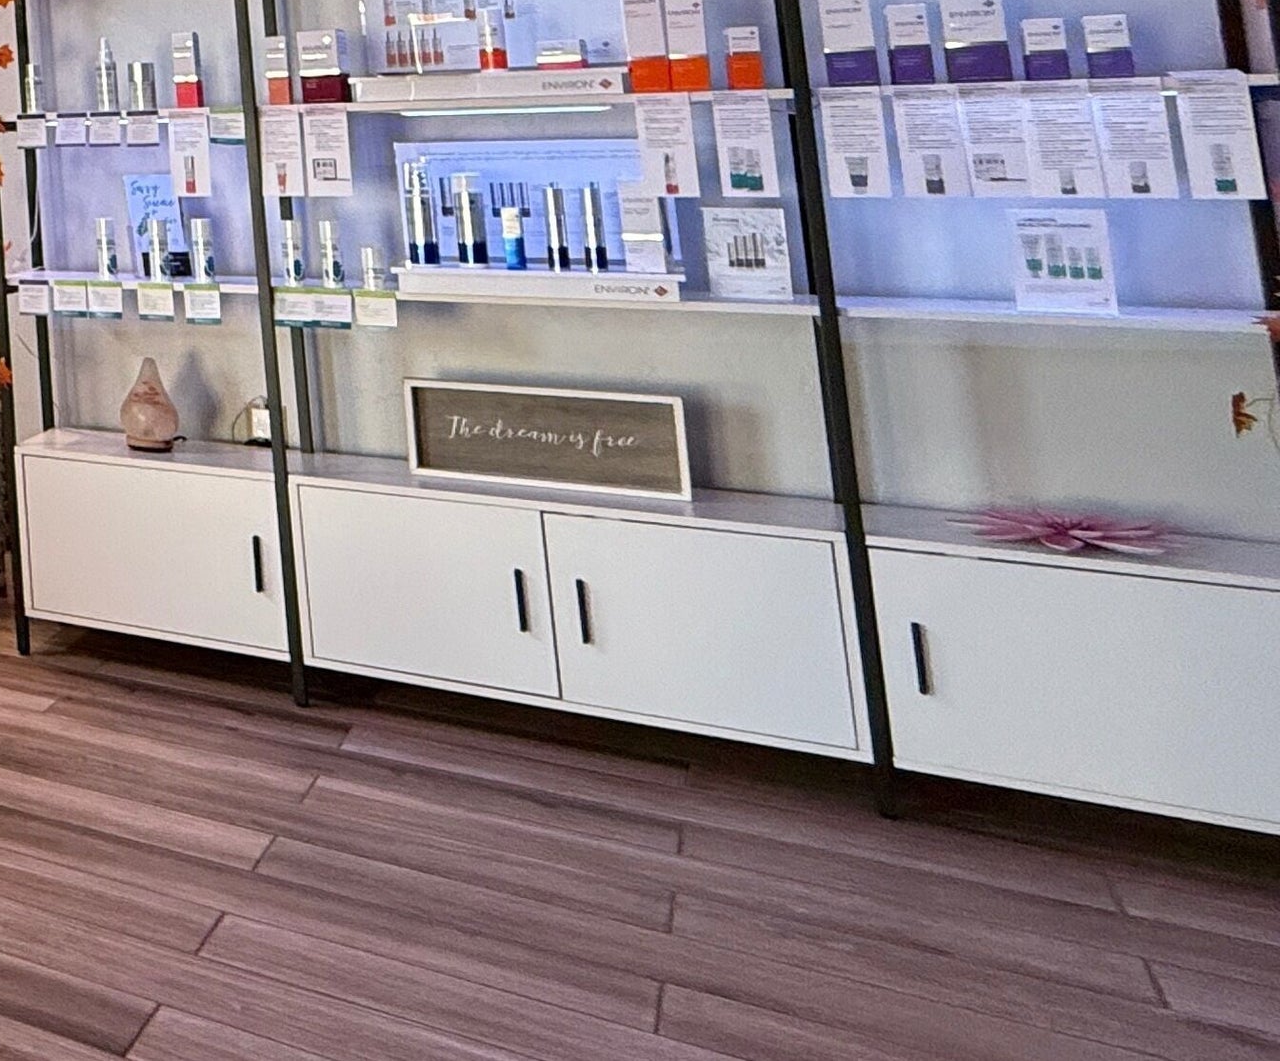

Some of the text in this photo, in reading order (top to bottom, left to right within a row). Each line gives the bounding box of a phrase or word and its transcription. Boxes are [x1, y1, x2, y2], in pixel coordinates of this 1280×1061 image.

[446, 415, 639, 458] The dream is free
